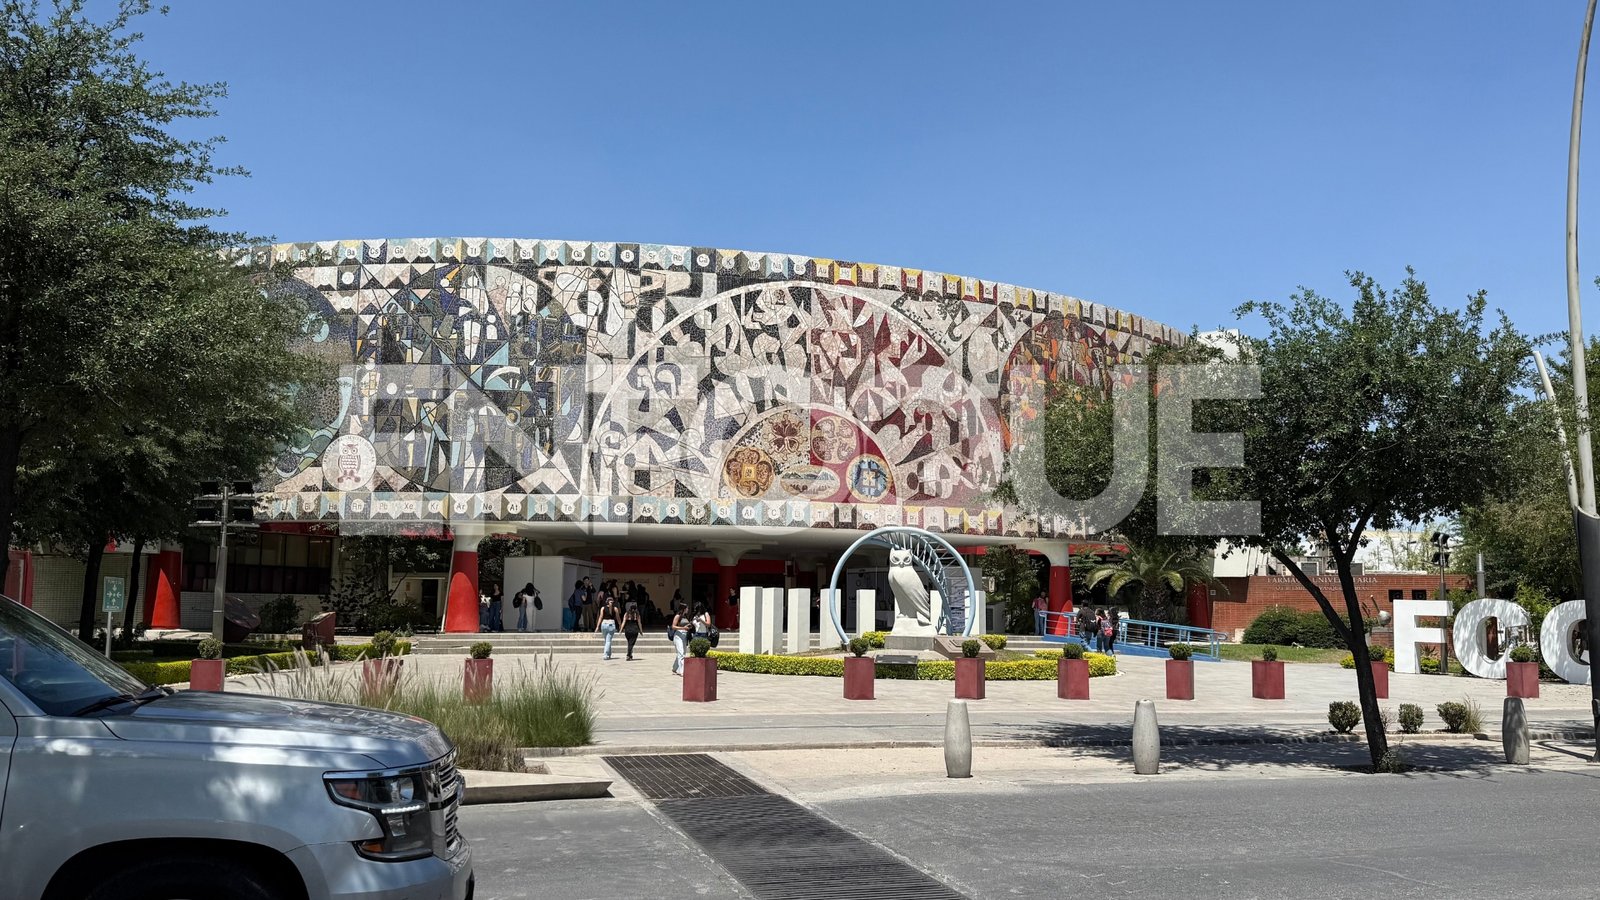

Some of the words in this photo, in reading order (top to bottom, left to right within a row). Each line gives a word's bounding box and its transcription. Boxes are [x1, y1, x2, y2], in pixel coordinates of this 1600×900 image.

[522, 249, 531, 257] Sn
[648, 252, 656, 260] Sr
[929, 280, 936, 288] Fe
[404, 502, 414, 510] Xe
[456, 502, 465, 510] Ar
[642, 506, 651, 514] As
[744, 509, 752, 517] Al
